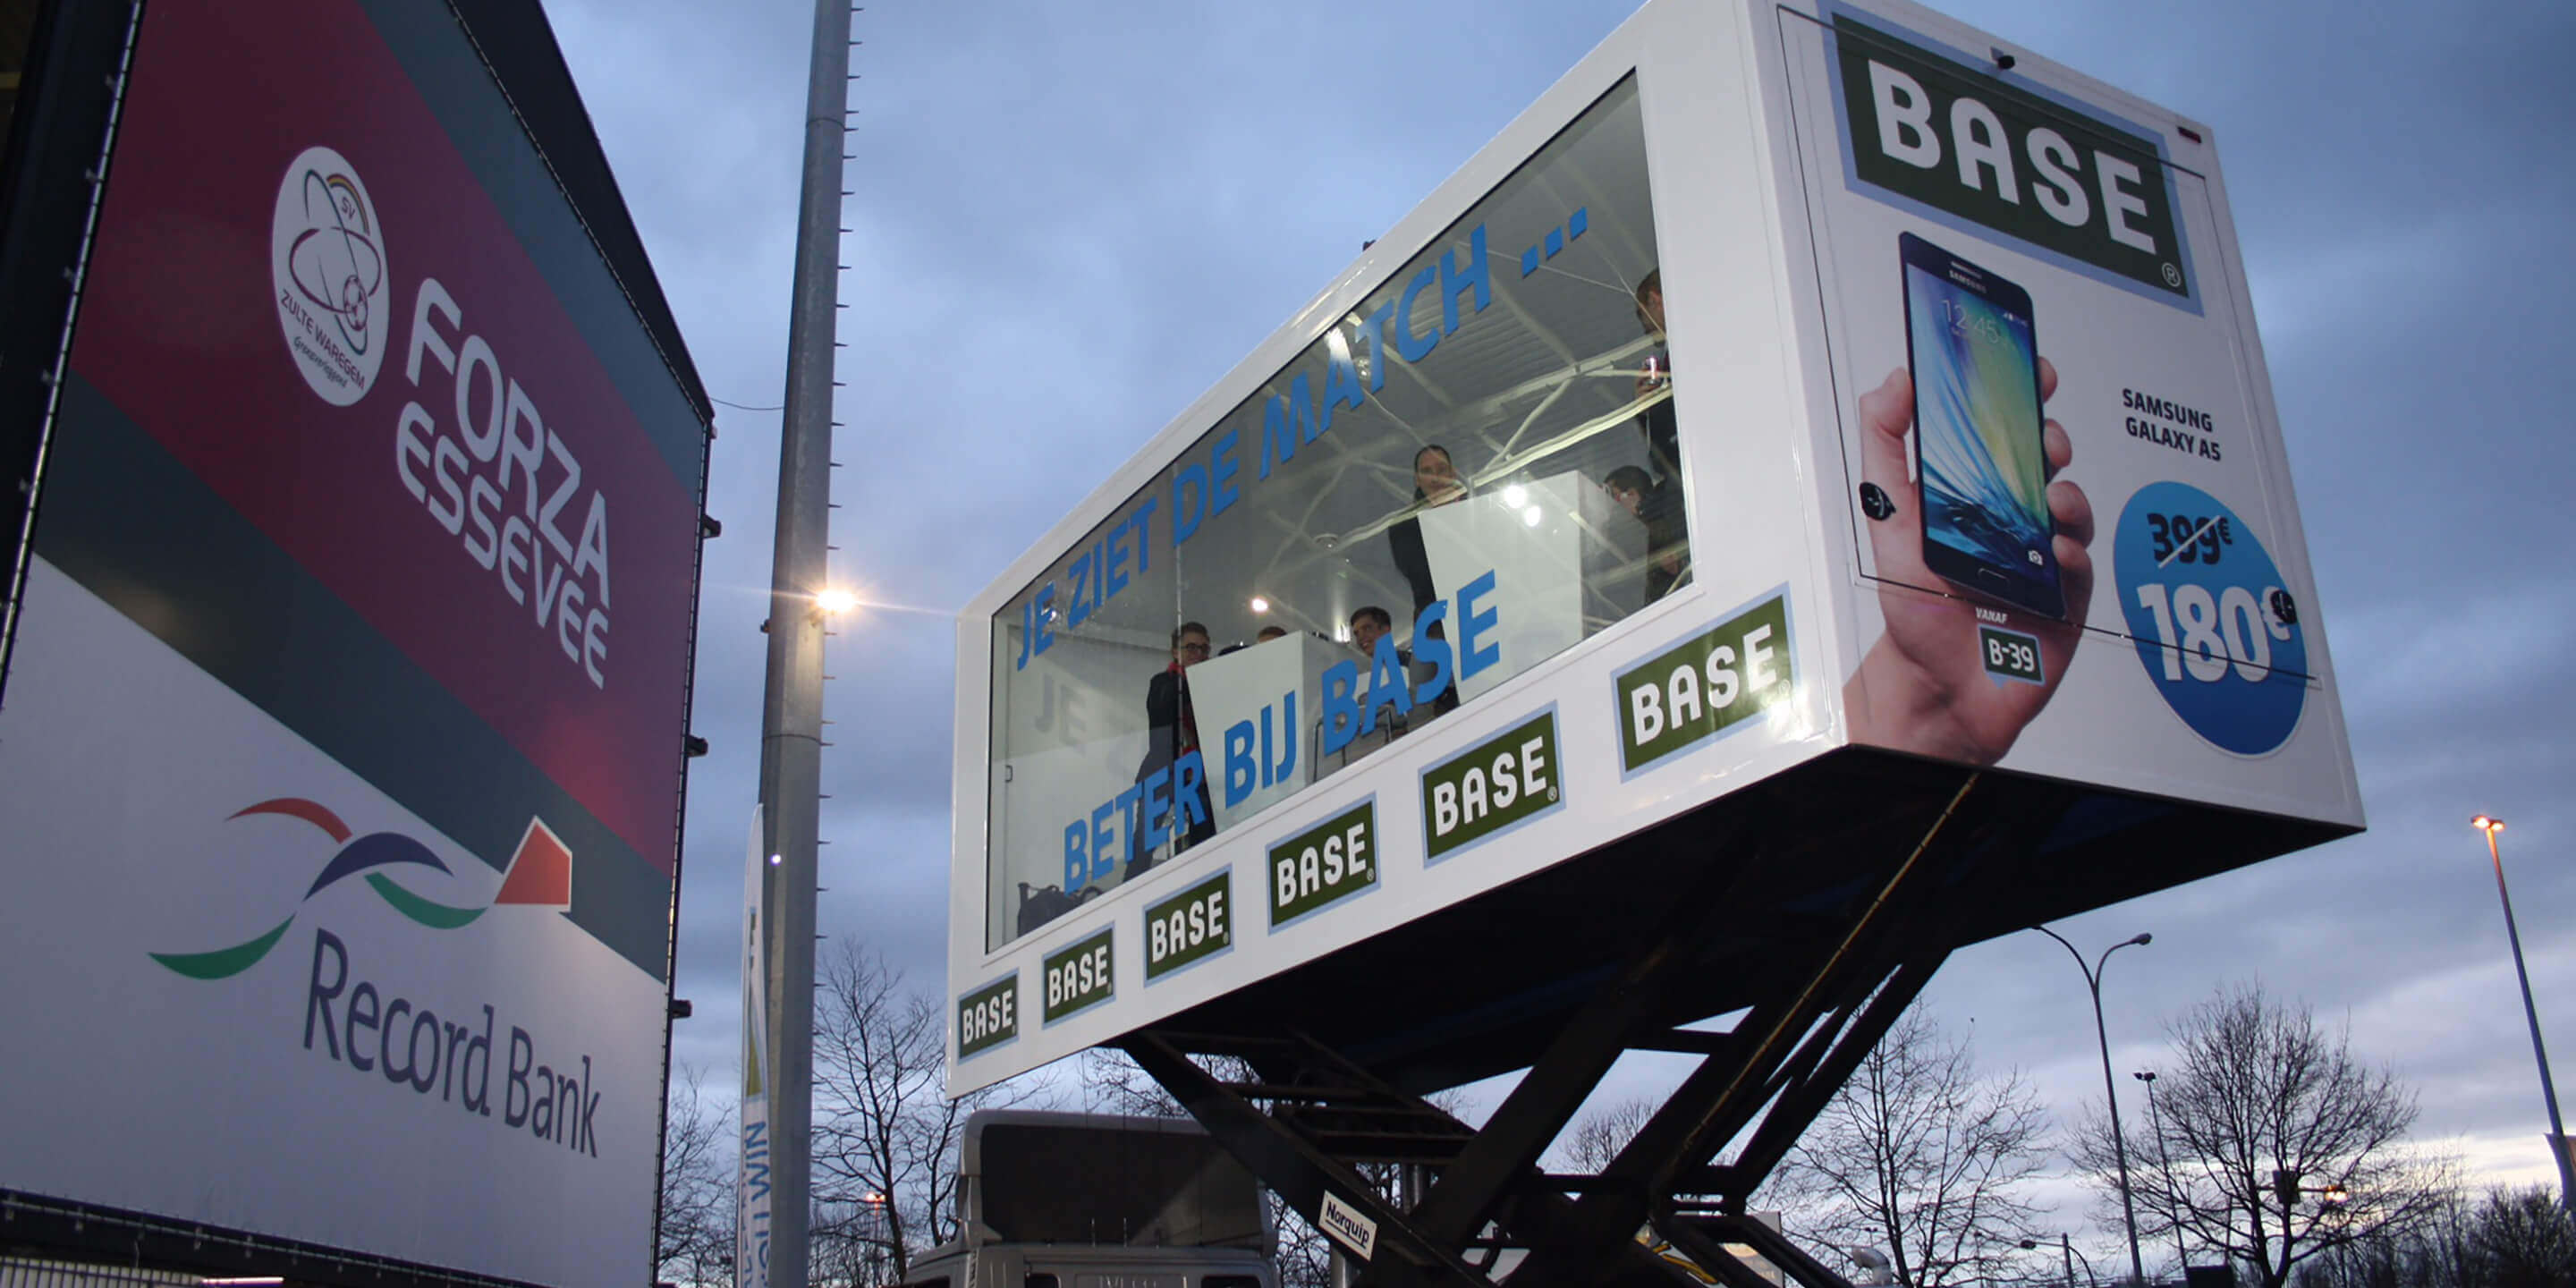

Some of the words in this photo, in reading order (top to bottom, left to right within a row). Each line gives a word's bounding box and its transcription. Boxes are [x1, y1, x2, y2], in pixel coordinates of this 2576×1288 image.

[1868, 58, 2157, 254] BASE
[340, 196, 356, 220] SV
[280, 288, 315, 335] ZULTE
[315, 323, 366, 391] WAREGEM
[405, 277, 610, 611] FORZA
[1016, 580, 1055, 672] JE
[1066, 497, 1157, 631] ZIET
[1172, 429, 1241, 548] DE
[1258, 221, 1491, 481] MATCH
[2122, 387, 2213, 433] SAMSUNG
[2125, 416, 2195, 454] GALAXY
[2199, 438, 2221, 462] A5
[396, 401, 609, 691] ESSEVEE
[1975, 606, 2008, 624] VANAF
[1987, 638, 2035, 673] B-39
[1630, 623, 1776, 747] BASE
[1063, 749, 1208, 896] BETER
[1224, 690, 1297, 810] BIJ
[1320, 568, 1501, 758] BASE
[1433, 736, 1547, 837] BASE
[1276, 822, 1368, 909] BASE
[1150, 890, 1224, 964] BASE
[962, 988, 1013, 1046] BASE
[1047, 945, 1108, 1009] BASE
[302, 927, 495, 1118] Record
[504, 1025, 602, 1158] Bank
[744, 1121, 771, 1202] WIN
[1326, 1199, 1370, 1245] Norquip
